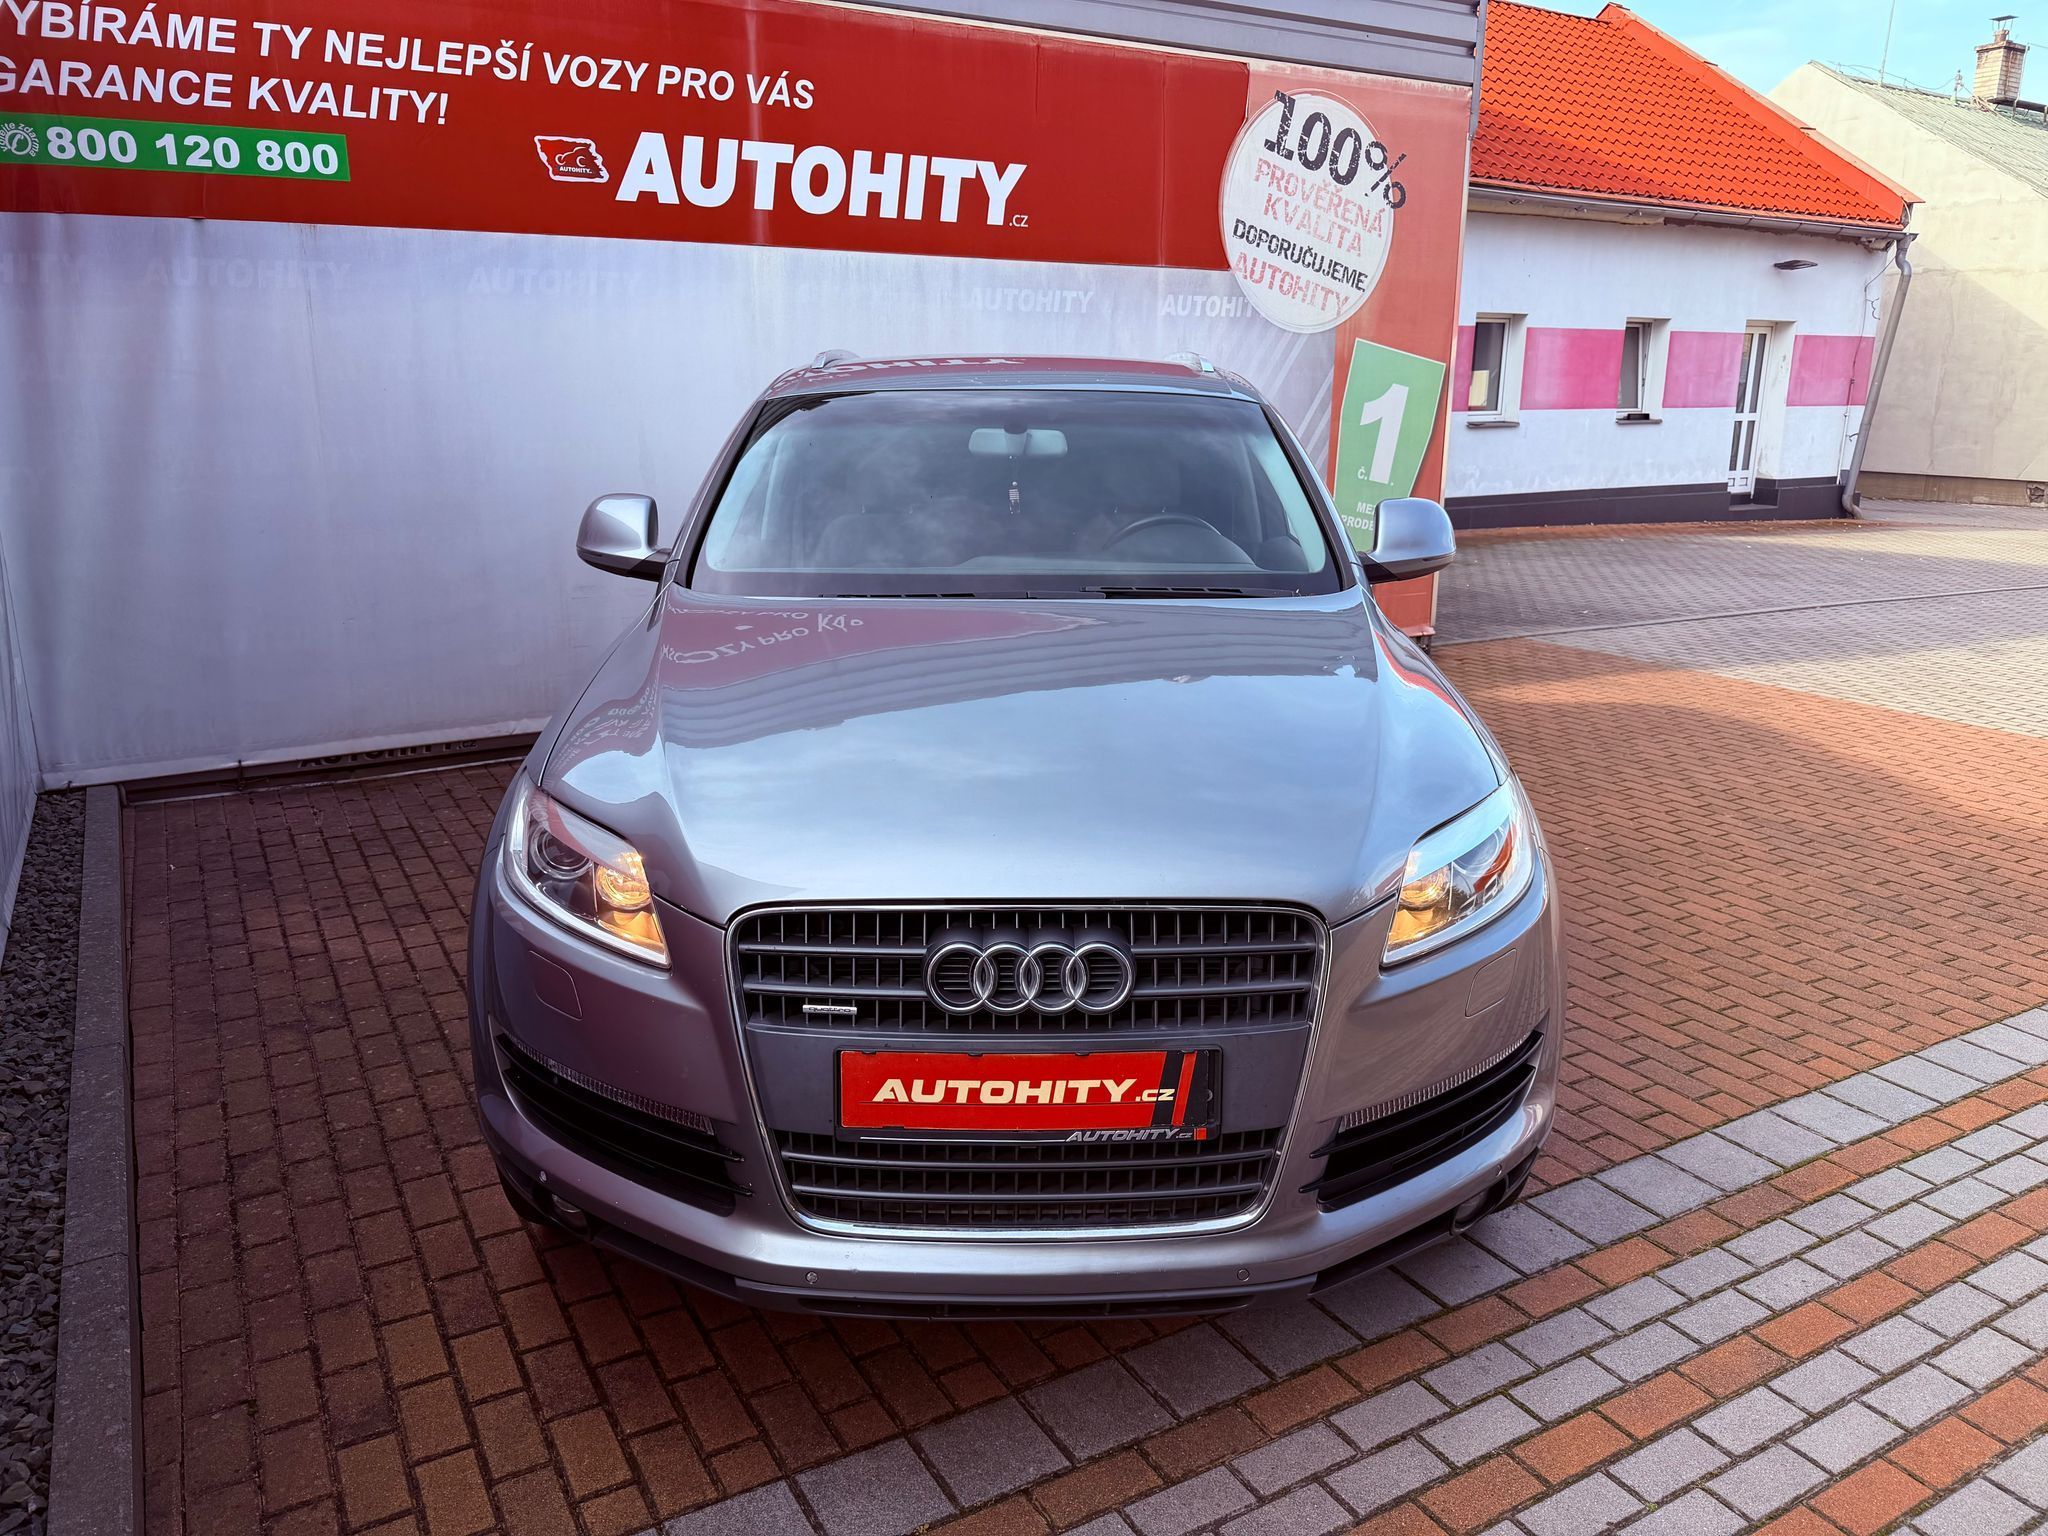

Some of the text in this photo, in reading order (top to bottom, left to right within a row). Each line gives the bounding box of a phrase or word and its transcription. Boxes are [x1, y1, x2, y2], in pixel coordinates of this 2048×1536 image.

[0, 0, 815, 109] YBÍRÁME TY NEJLEPŠÍ VOZY PRO VÁS
[0, 55, 449, 125] GARANCE KVALITY!
[46, 126, 339, 175] 800 120 800
[1263, 90, 1407, 210] 100%
[1254, 157, 1386, 238] PROVĚŘENÁ
[1263, 193, 1363, 257] KVALITA
[1232, 218, 1369, 293] DOPORUČUJEME
[1233, 251, 1351, 318] AUTOHITY
[967, 287, 1094, 313] AUTOHITY
[872, 1078, 1175, 1104] AUTOHITY.cz
[1066, 1128, 1193, 1142] AUTOHITY.cz
